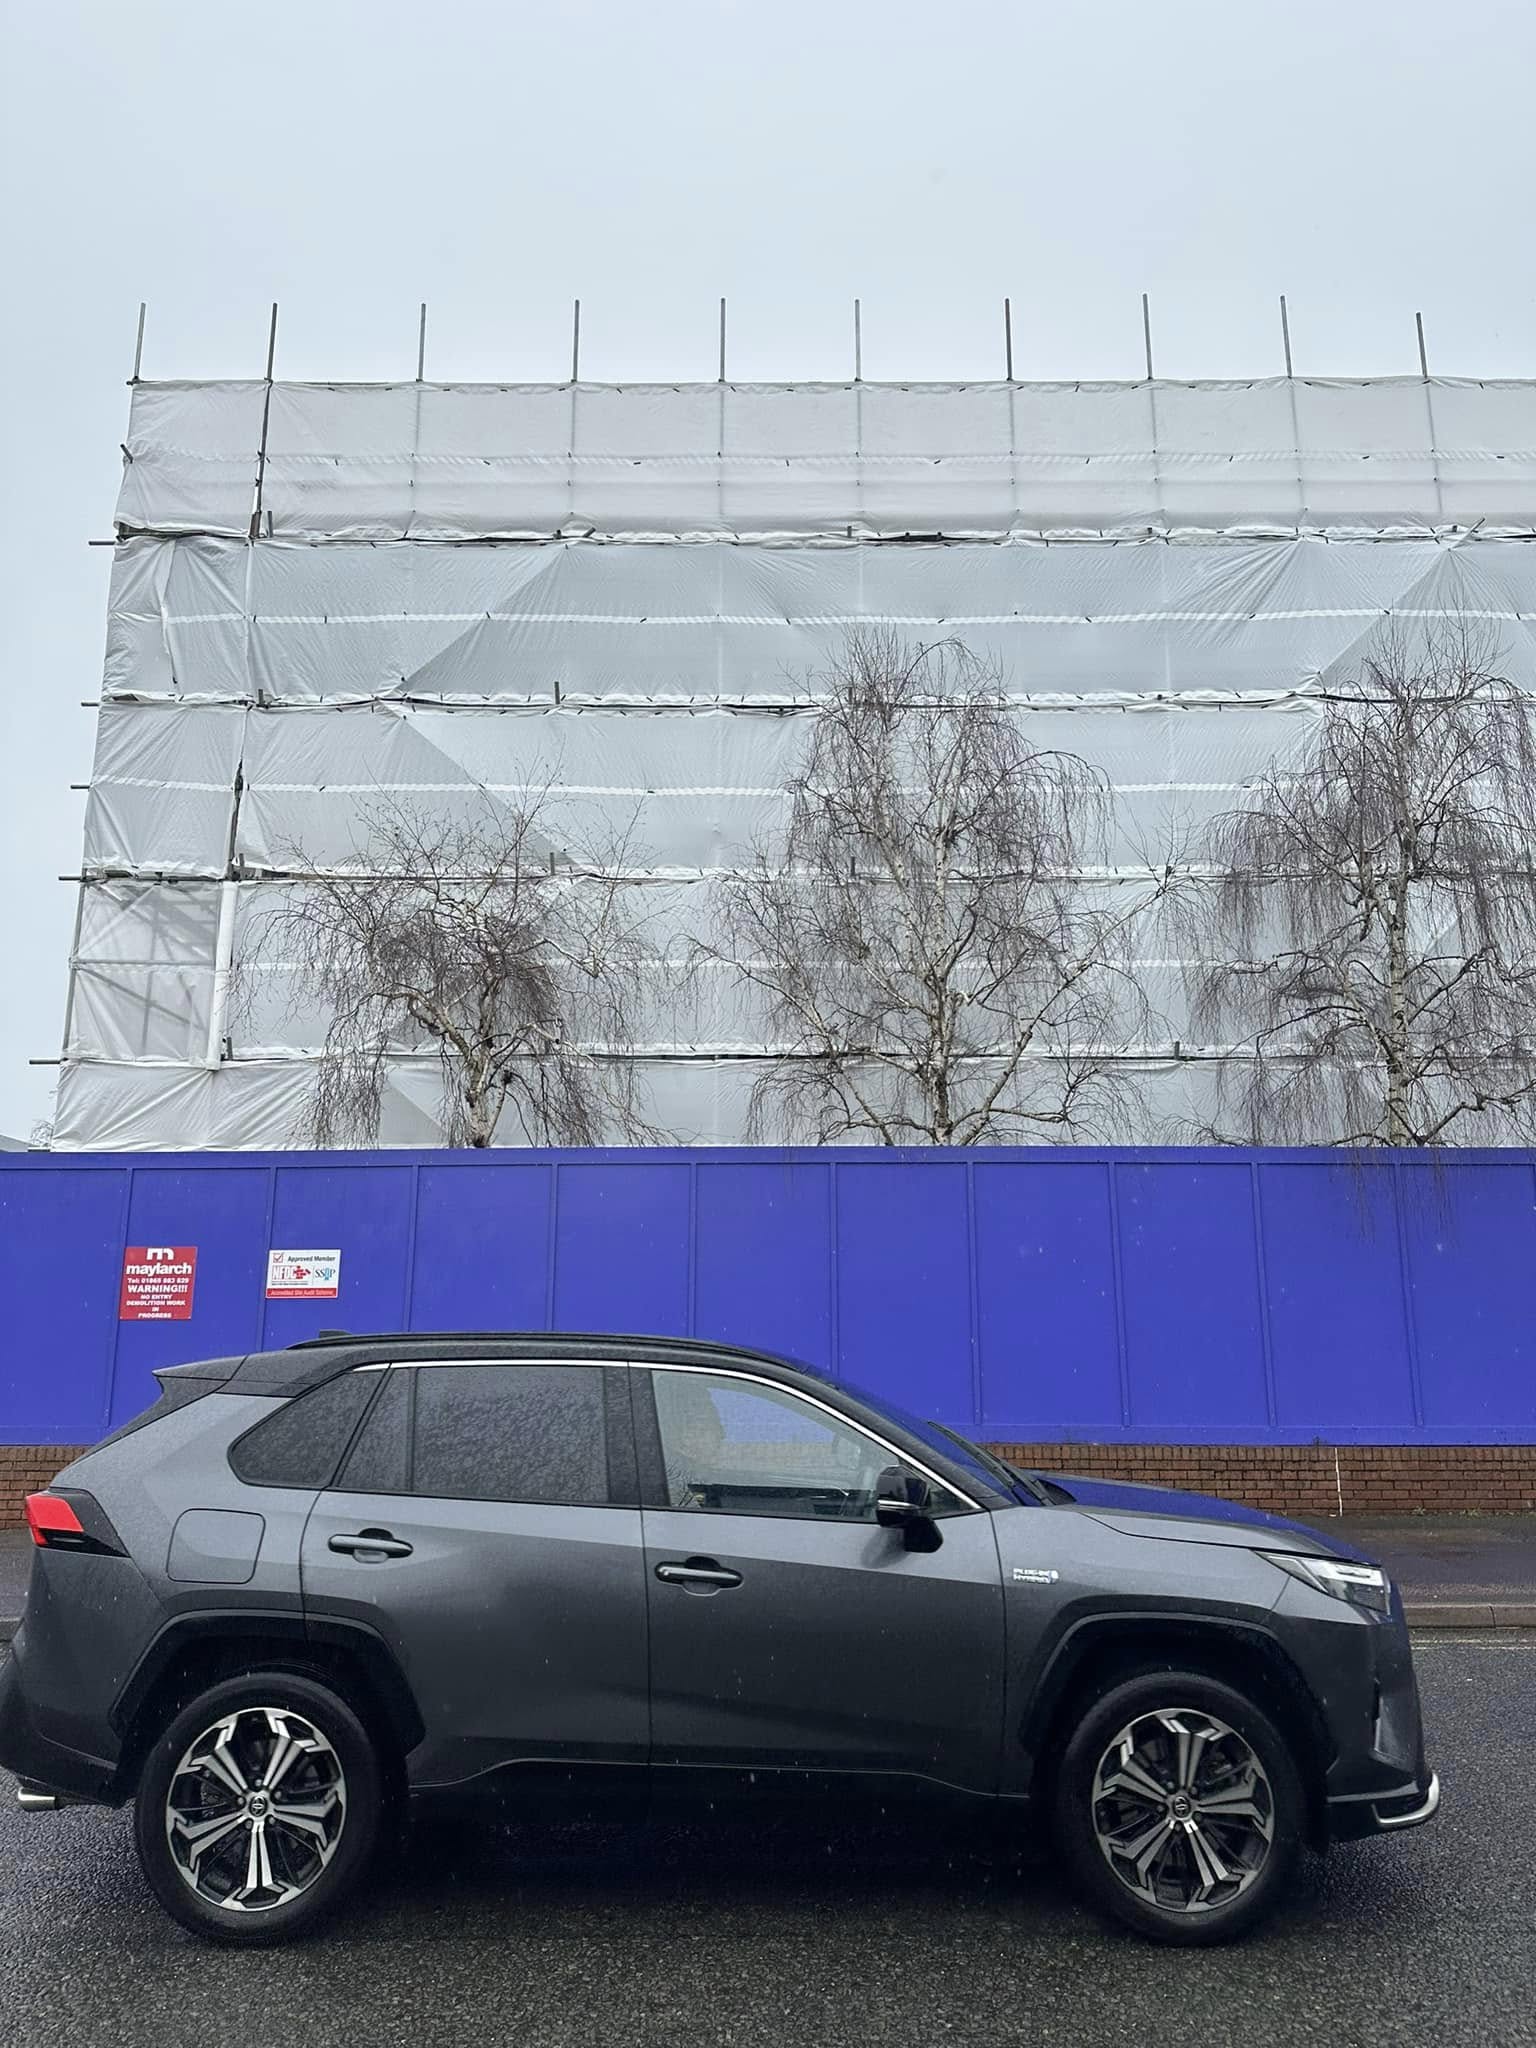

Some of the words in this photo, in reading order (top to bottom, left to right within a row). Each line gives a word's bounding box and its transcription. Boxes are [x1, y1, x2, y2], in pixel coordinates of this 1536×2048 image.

[287, 1255, 314, 1263] Approved
[126, 1262, 193, 1277] maylarch
[271, 1265, 298, 1280] NFDC
[127, 1284, 188, 1293] WARNING!!!
